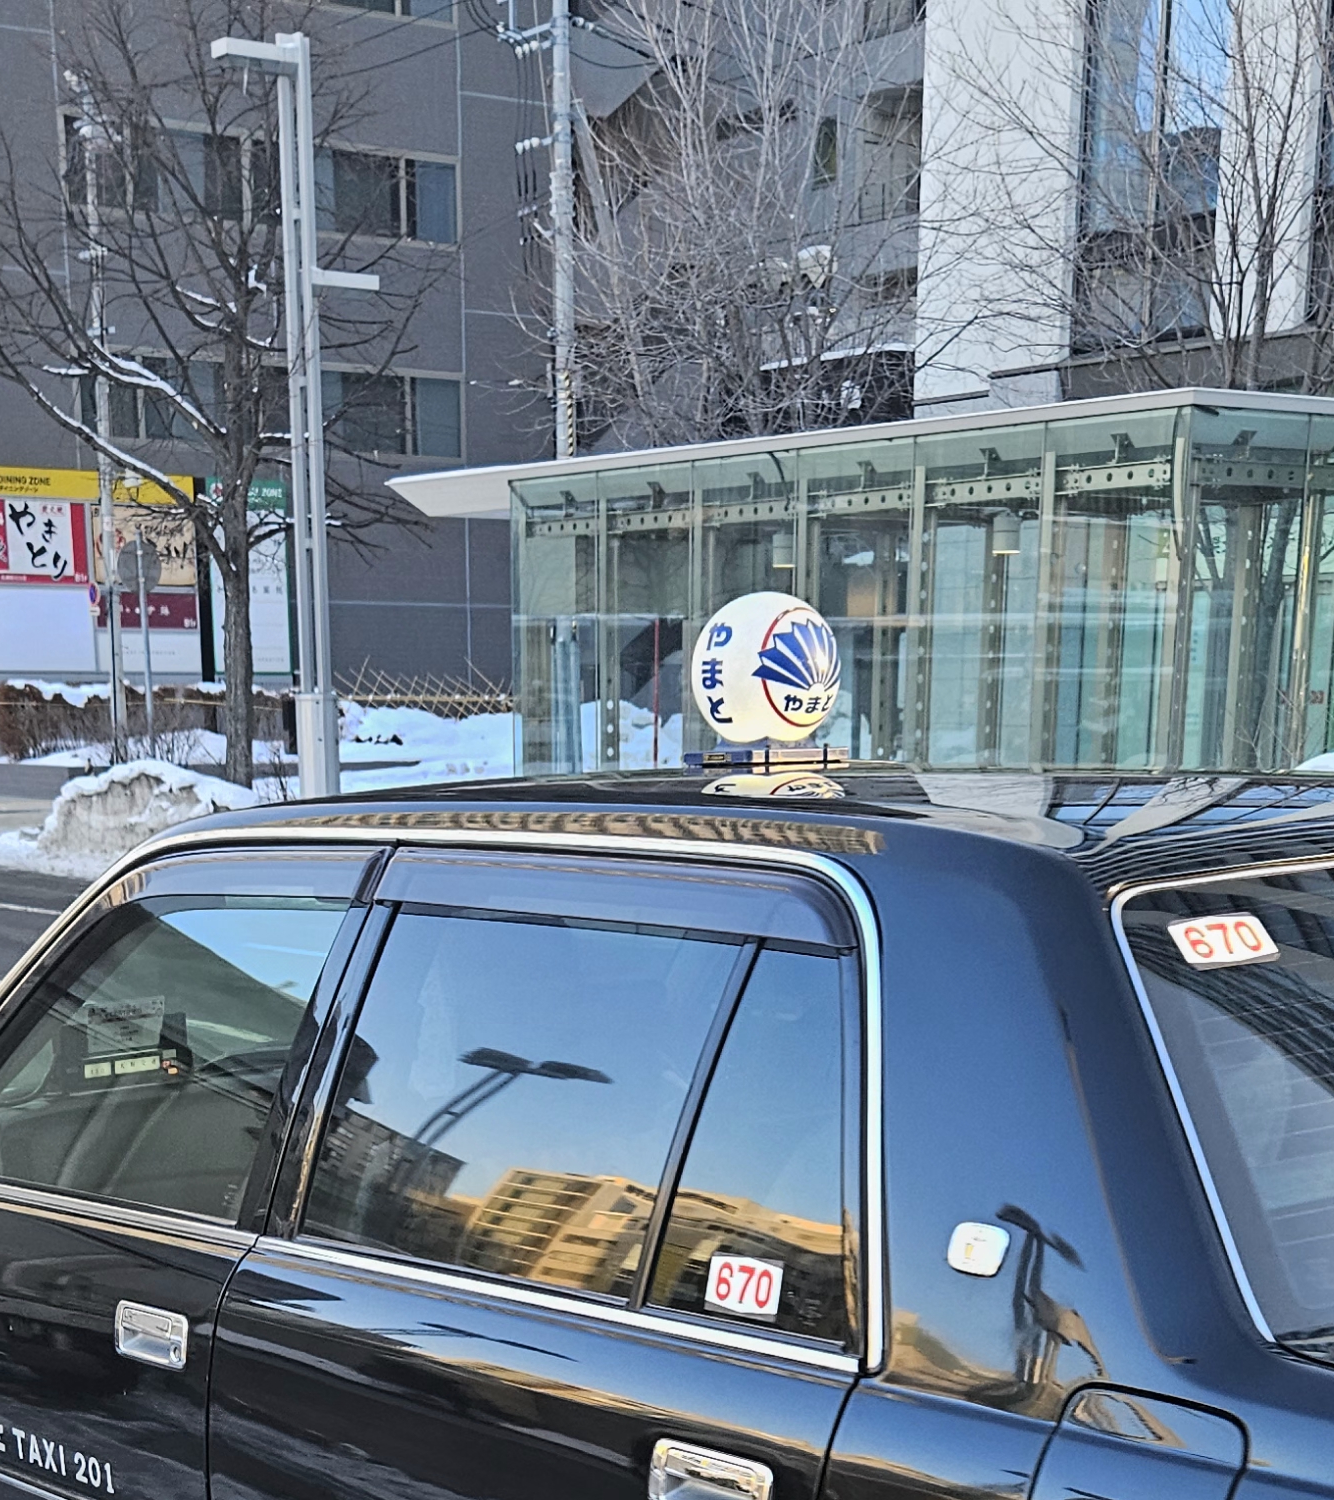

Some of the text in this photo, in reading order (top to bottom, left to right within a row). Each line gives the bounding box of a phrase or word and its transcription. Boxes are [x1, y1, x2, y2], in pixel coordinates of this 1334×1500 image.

[701, 622, 734, 724] やまと
[783, 694, 835, 714] やまと
[1184, 921, 1262, 959] 670
[715, 1261, 774, 1309] 670
[12, 1427, 67, 1476] TAXI
[73, 1451, 115, 1494] 201
